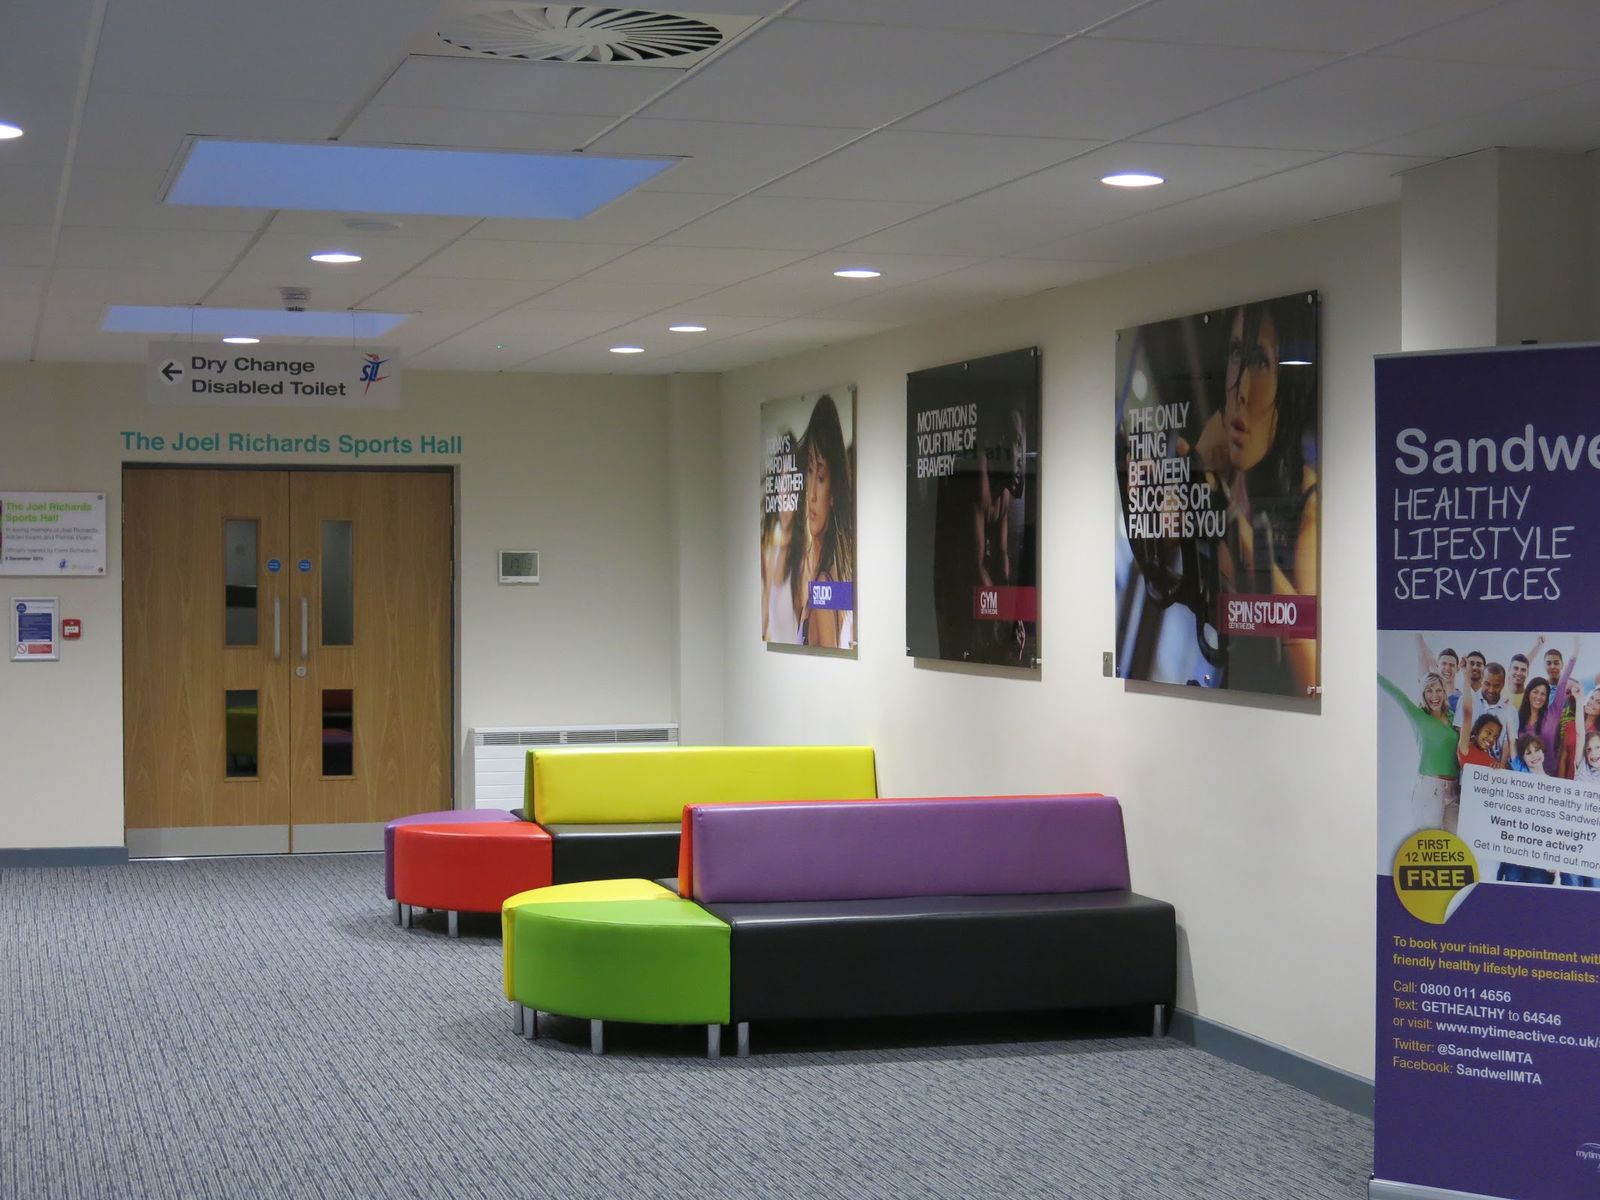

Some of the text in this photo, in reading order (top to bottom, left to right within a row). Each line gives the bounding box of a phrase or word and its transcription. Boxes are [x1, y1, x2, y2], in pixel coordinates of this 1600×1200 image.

[191, 356, 315, 375] Dry Change
[192, 379, 346, 396] Disabled Toilet
[917, 402, 977, 433] MOTIVATION IS
[1128, 401, 1190, 433] THE ONLY
[120, 431, 462, 458] The Joel Richards Sports Hall
[917, 432, 941, 456] YOUR
[942, 429, 963, 453] TIME
[964, 427, 977, 450] OF
[1128, 431, 1167, 460] THING
[766, 453, 798, 474] HARD WILL
[917, 453, 956, 479] BRAVERY
[1128, 456, 1190, 487] BETWEEN
[766, 473, 804, 494] BE ANOTHER
[6, 502, 92, 512] The Joel Richards
[766, 492, 799, 513] DAY'S EASY
[1128, 482, 1211, 513] SUCCESS OR
[1394, 485, 1531, 521] HEALTHY
[5, 513, 59, 523] Sports Hall
[1128, 510, 1226, 539] FAILURE IS YOU
[1394, 525, 1575, 561] LIFESTYLE
[813, 585, 832, 601] STUDIO
[1394, 567, 1561, 602] SERVICES
[980, 591, 998, 609] GYM
[1228, 600, 1297, 625] SPIN STUDIO
[1473, 770, 1489, 781] Did
[1491, 775, 1508, 785] you
[1510, 777, 1535, 789] know
[1537, 782, 1561, 793] there
[1564, 786, 1572, 795] is
[1583, 790, 1600, 801] ran
[1473, 785, 1504, 798] weight
[1506, 790, 1525, 801] loss
[1527, 794, 1545, 804] and
[1547, 797, 1582, 812] healthy
[1483, 800, 1522, 813] services
[1525, 807, 1556, 819] across
[1490, 815, 1597, 842] Want to lose weight?
[1500, 830, 1584, 853] Be more active?
[1405, 851, 1465, 863] 12 WEEKS
[1417, 839, 1451, 850] FIRST
[1473, 839, 1490, 850] Get
[1492, 843, 1501, 851] in
[1503, 845, 1529, 857] touch
[1531, 850, 1541, 859] to
[1543, 851, 1561, 863] find
[1563, 857, 1578, 866] out
[1406, 869, 1466, 888] FREE
[1393, 935, 1407, 947] To
[1409, 938, 1438, 950] book
[1440, 942, 1466, 953] your
[1468, 943, 1500, 955] initial
[1503, 946, 1578, 963] appointment
[1393, 953, 1599, 984] friendly healthy lifestyle specialists:
[1393, 980, 1512, 1003] Call: 0800 011 4656
[1393, 997, 1562, 1026] Text: GETHEALTHY to 64546
[1393, 1017, 1405, 1026] or
[1408, 1017, 1433, 1030] visit:
[1393, 1037, 1533, 1065] Twitter: @SandwellMTA
[1393, 1056, 1542, 1085] Facebook: SandwellMTA
